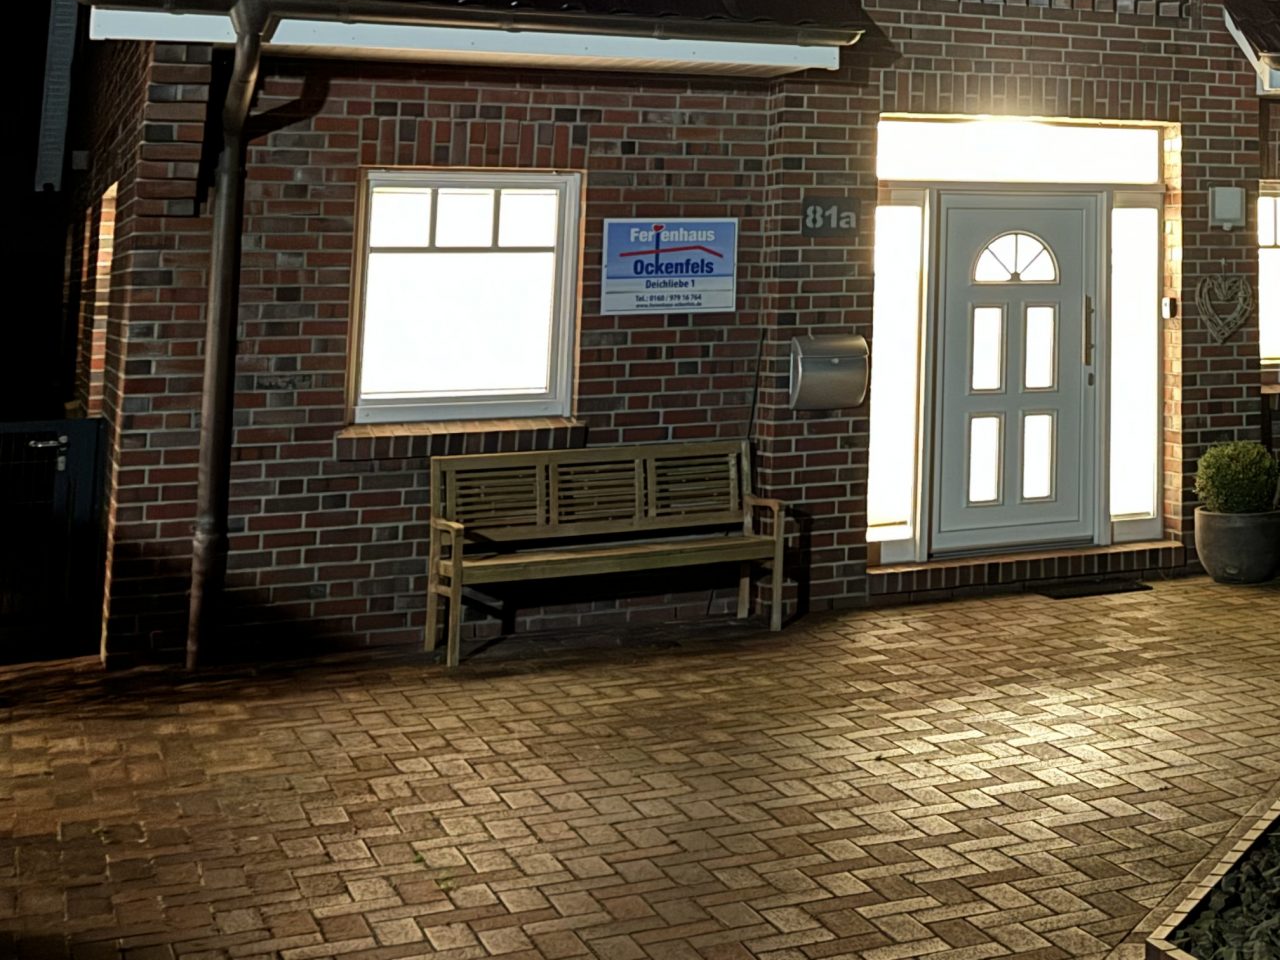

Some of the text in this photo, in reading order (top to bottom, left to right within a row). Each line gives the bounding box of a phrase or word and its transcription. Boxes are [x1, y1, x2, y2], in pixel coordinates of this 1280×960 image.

[806, 205, 856, 228] 81a
[633, 258, 714, 275] Ockenfels
[645, 279, 695, 289] Deichliebe 1
